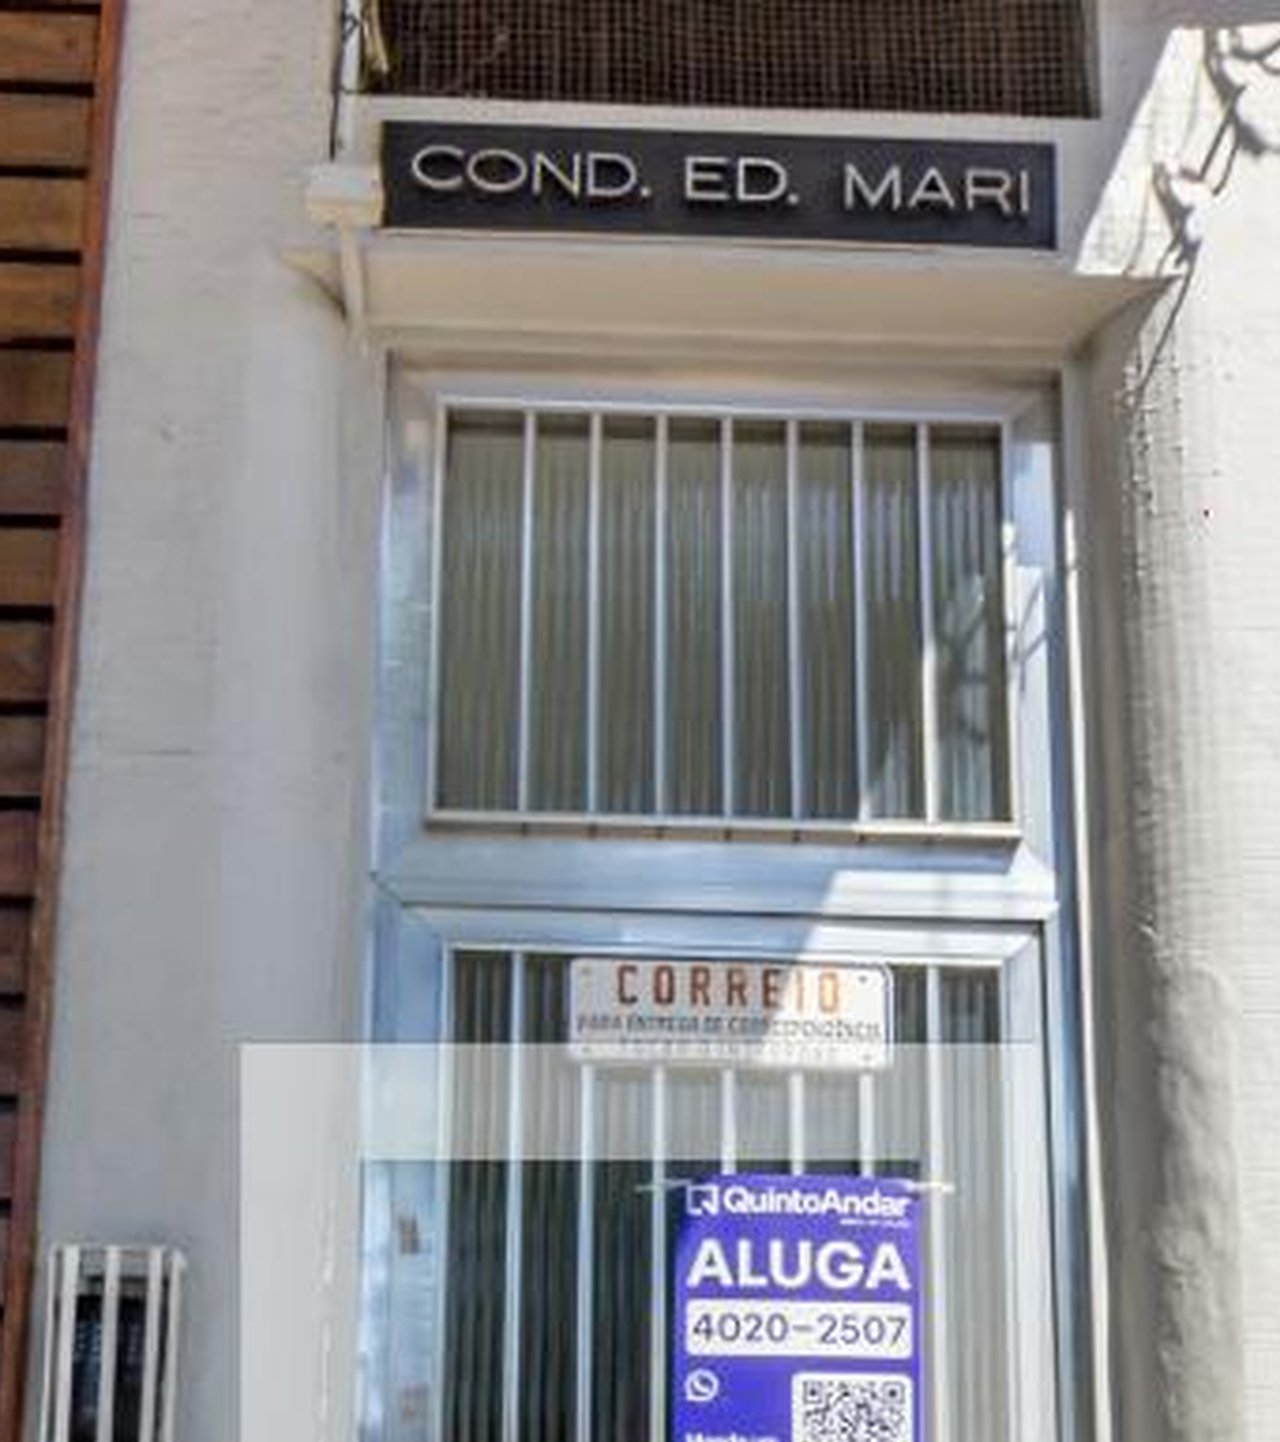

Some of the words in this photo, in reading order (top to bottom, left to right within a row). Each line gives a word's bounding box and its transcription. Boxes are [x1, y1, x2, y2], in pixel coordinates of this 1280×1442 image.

[411, 145, 651, 199] COND.
[683, 157, 799, 206] ED.
[844, 163, 1030, 213] MARI
[616, 963, 841, 1014] CORREIO
[722, 1185, 913, 1218] QuintoAndar
[686, 1238, 913, 1291] ALUGA
[692, 1313, 907, 1346] 4020-2507
